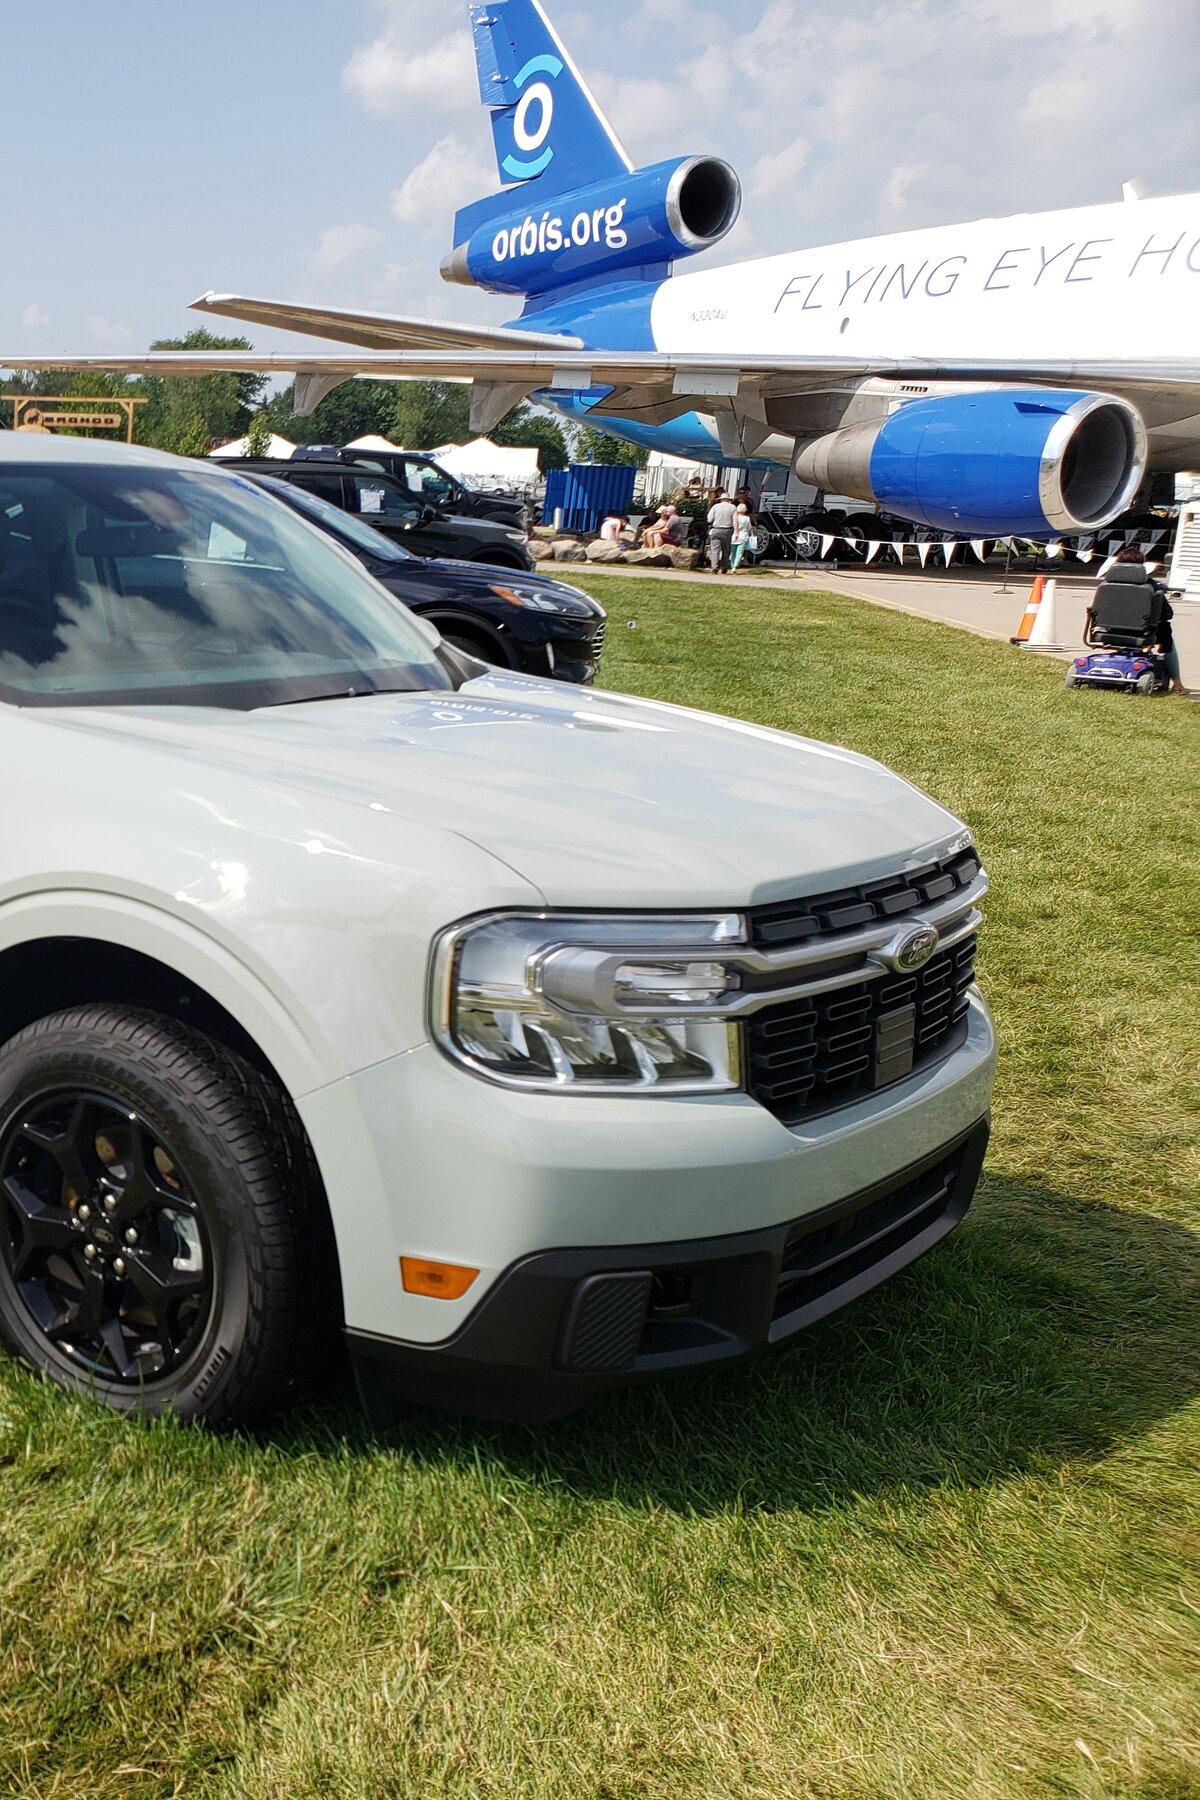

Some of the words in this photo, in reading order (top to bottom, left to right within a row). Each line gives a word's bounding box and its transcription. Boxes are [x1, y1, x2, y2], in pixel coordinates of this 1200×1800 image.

[491, 197, 628, 262] orbis.org
[773, 255, 967, 314] FLYING
[983, 237, 1114, 292] EYE
[44, 416, 114, 426] BRONCO
[908, 936, 933, 964] Ford
